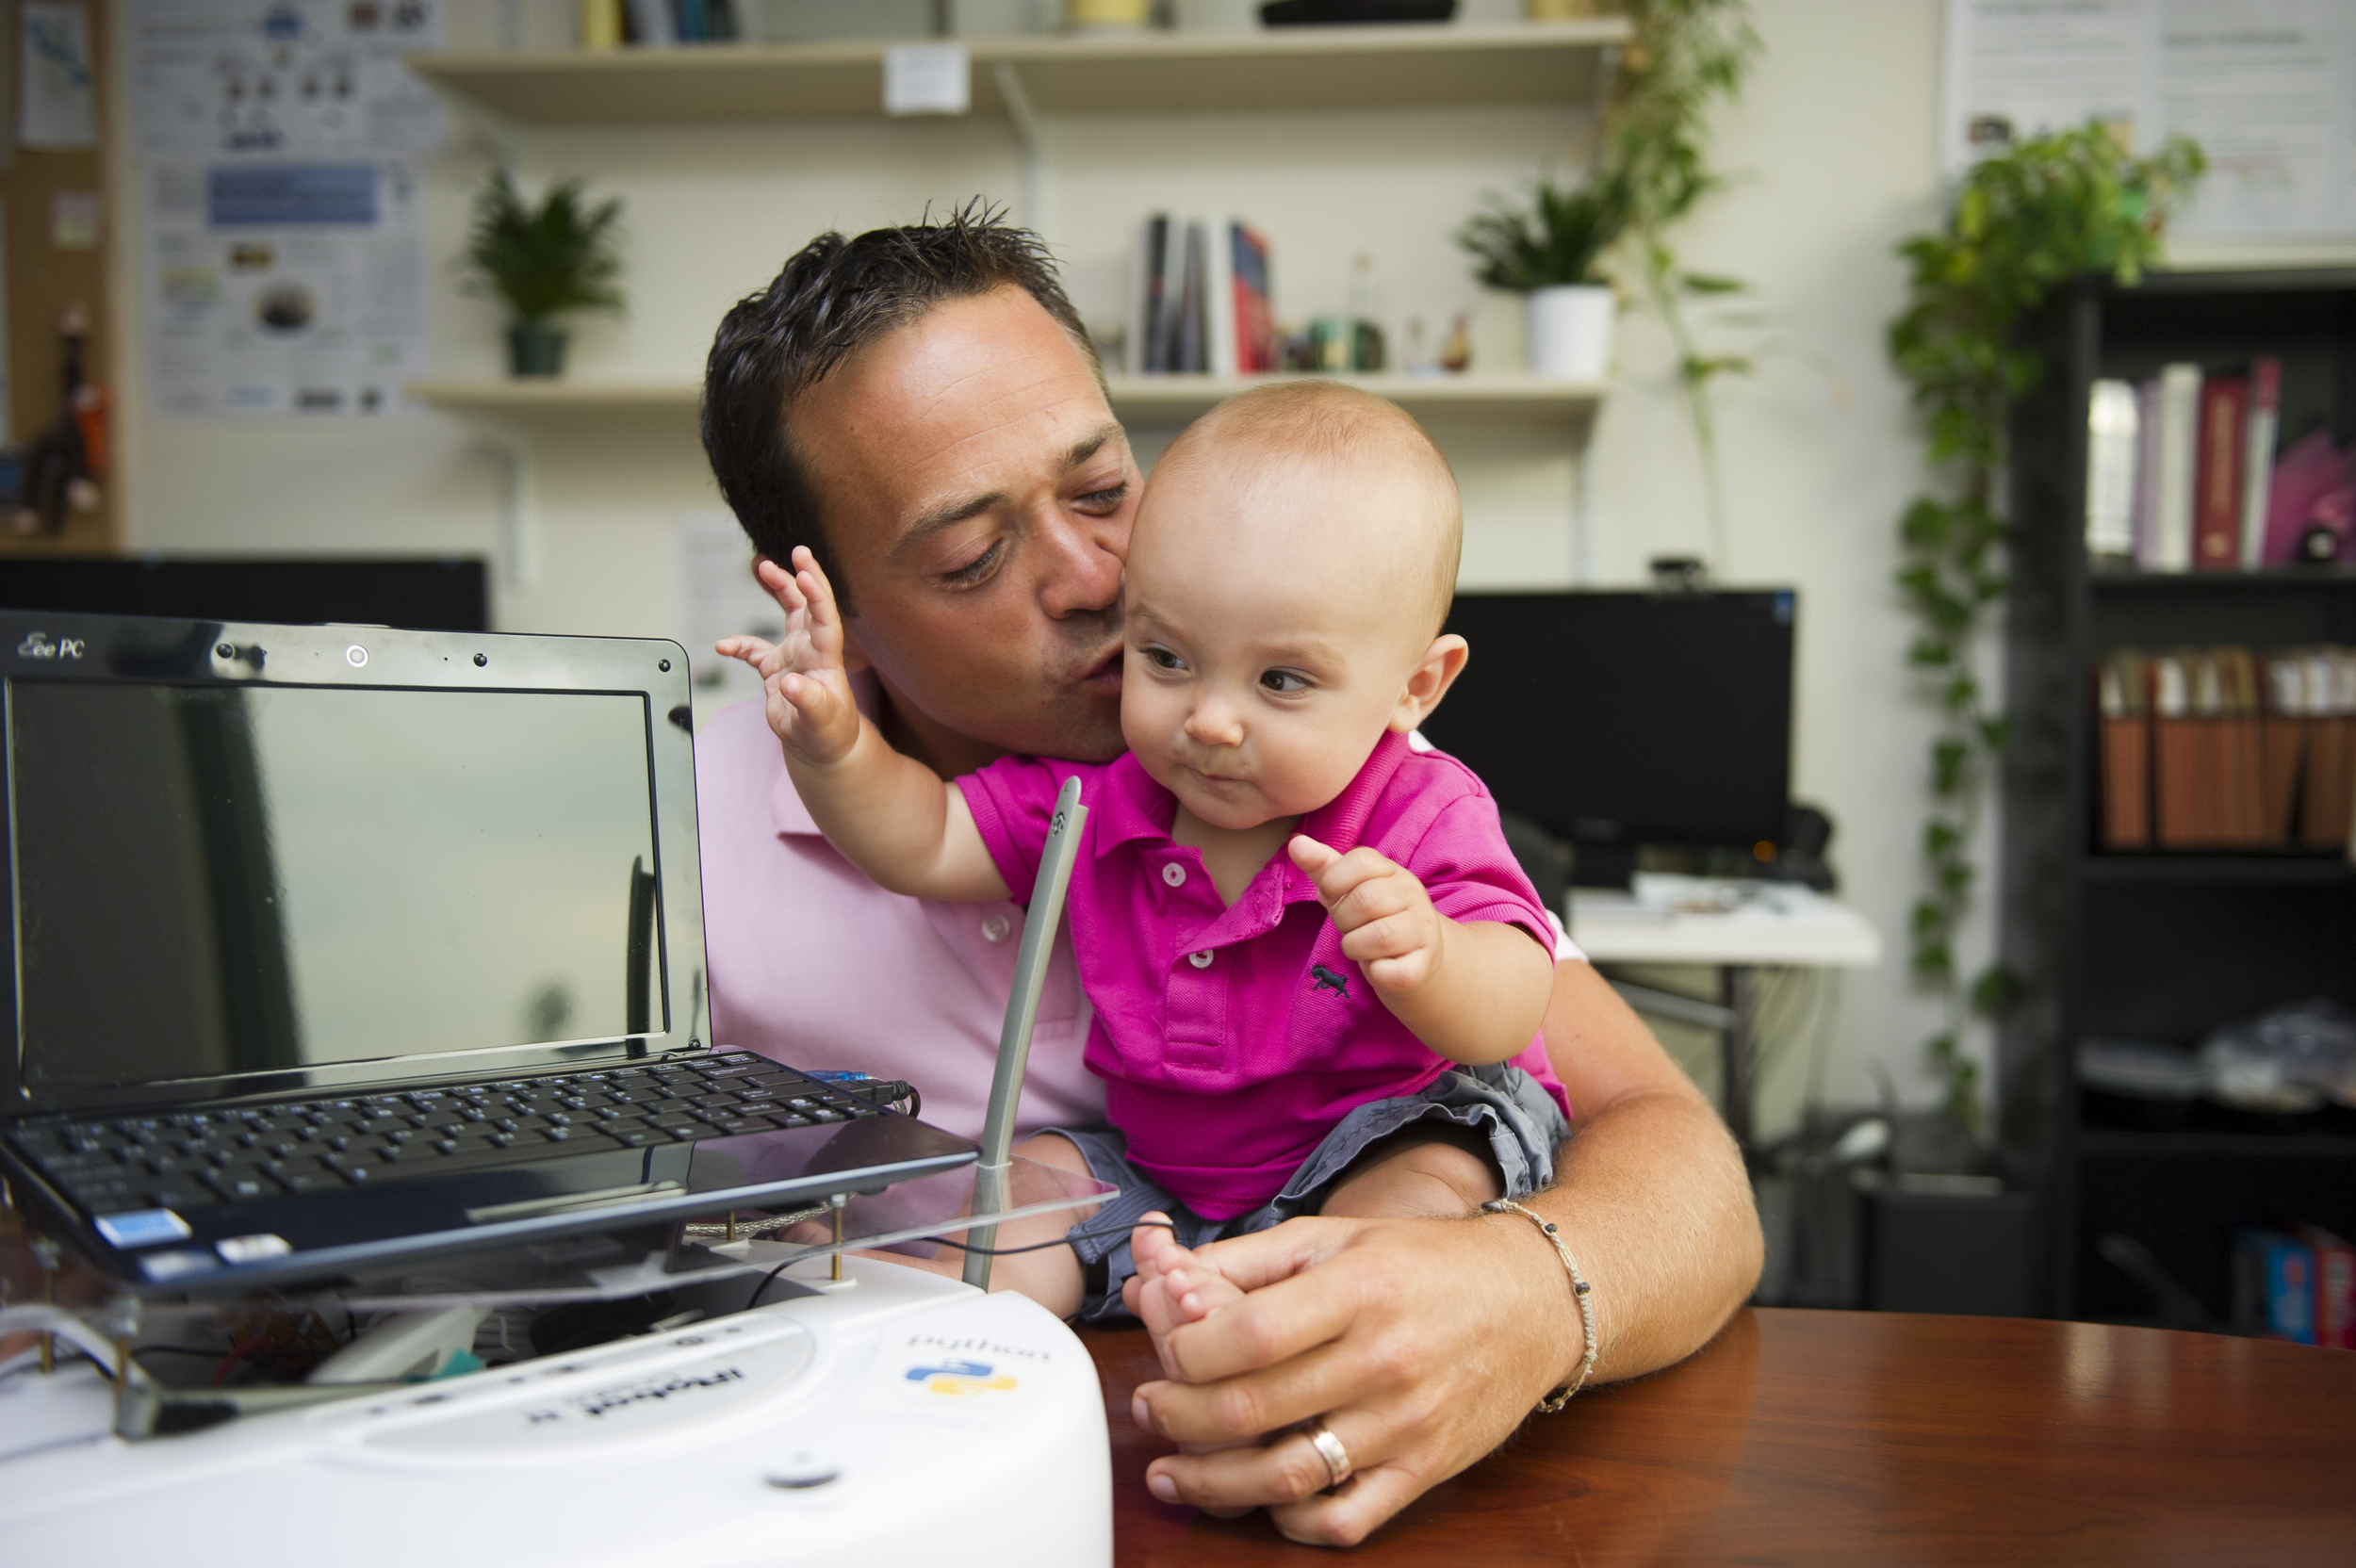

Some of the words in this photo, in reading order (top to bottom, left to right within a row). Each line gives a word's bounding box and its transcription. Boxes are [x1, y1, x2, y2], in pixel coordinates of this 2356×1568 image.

[18, 632, 56, 658] Eee
[58, 638, 85, 660] PC
[908, 1333, 1050, 1360] python
